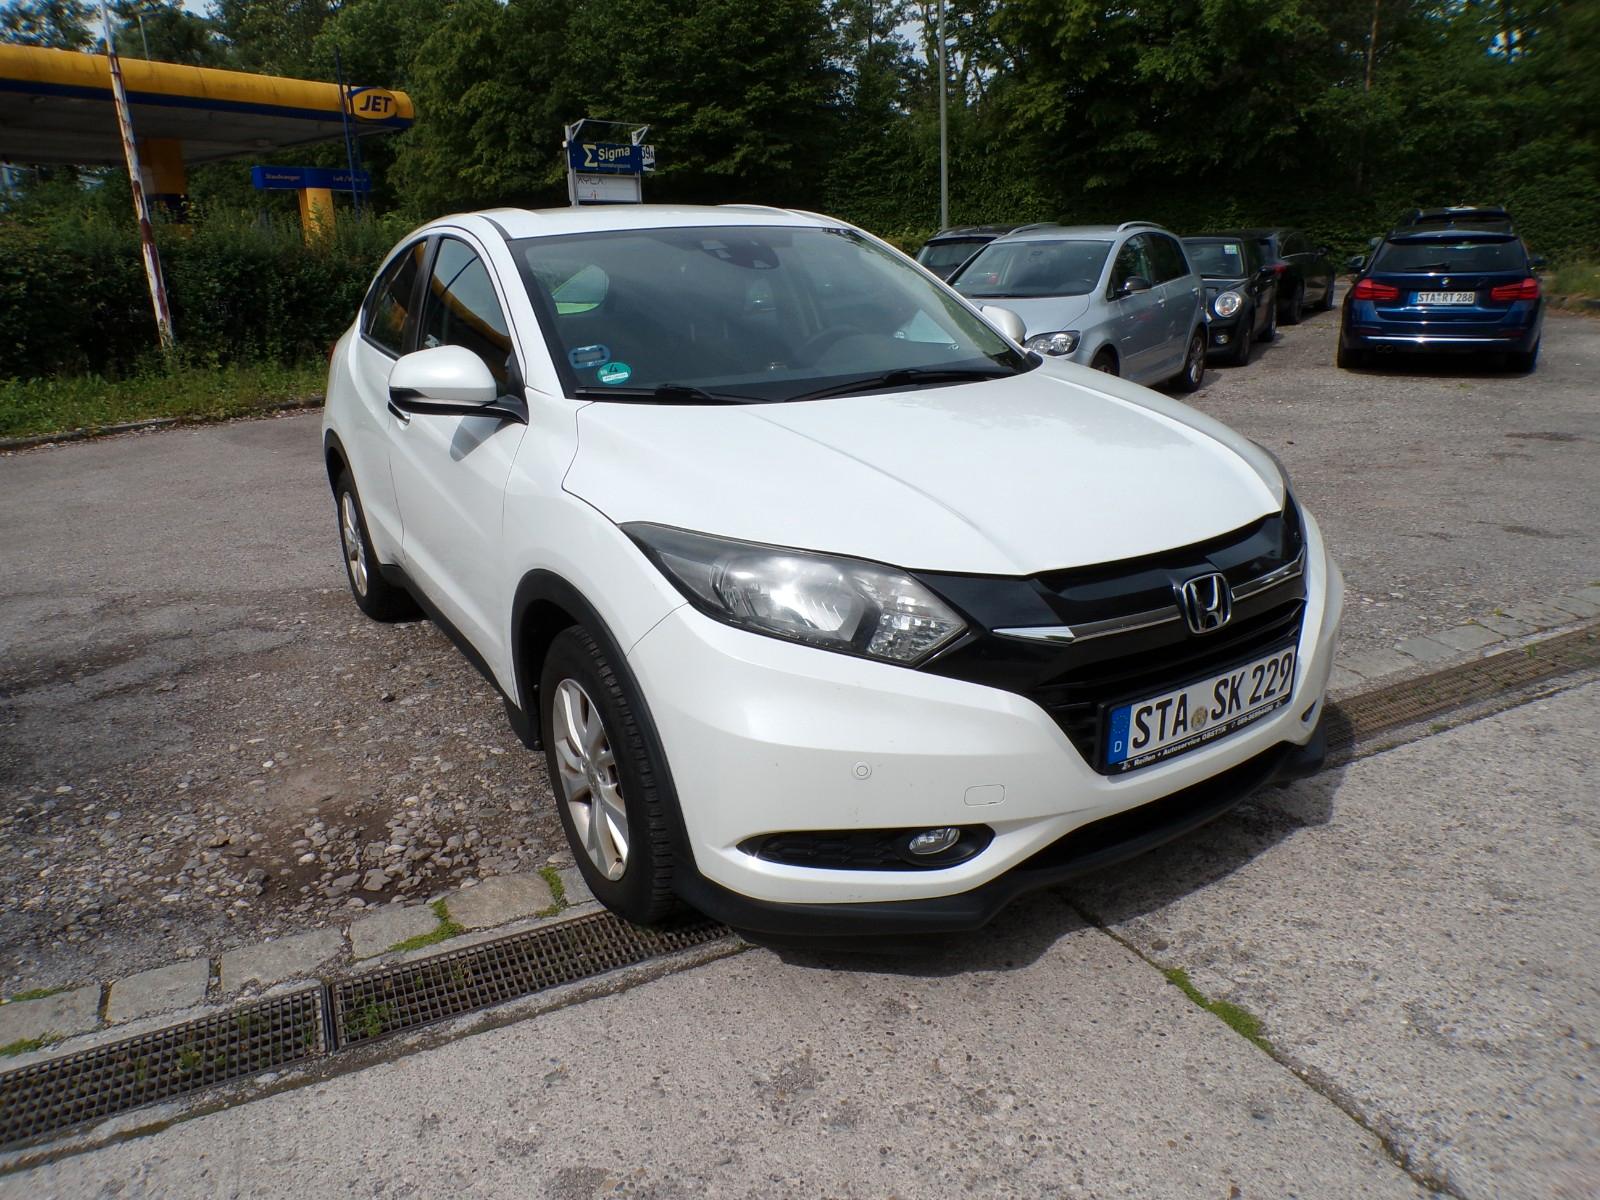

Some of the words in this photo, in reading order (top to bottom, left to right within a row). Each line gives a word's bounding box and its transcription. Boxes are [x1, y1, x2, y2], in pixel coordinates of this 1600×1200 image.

[359, 95, 393, 113] JET
[598, 146, 631, 162] Sigma
[1418, 293, 1436, 302] STA
[1442, 293, 1454, 302] RT
[608, 363, 618, 372] 4
[1132, 692, 1188, 749] STA
[1210, 671, 1245, 721] SK
[1248, 652, 1293, 705] 229
[1114, 740, 1122, 753] D
[1163, 737, 1201, 756] Autoservice
